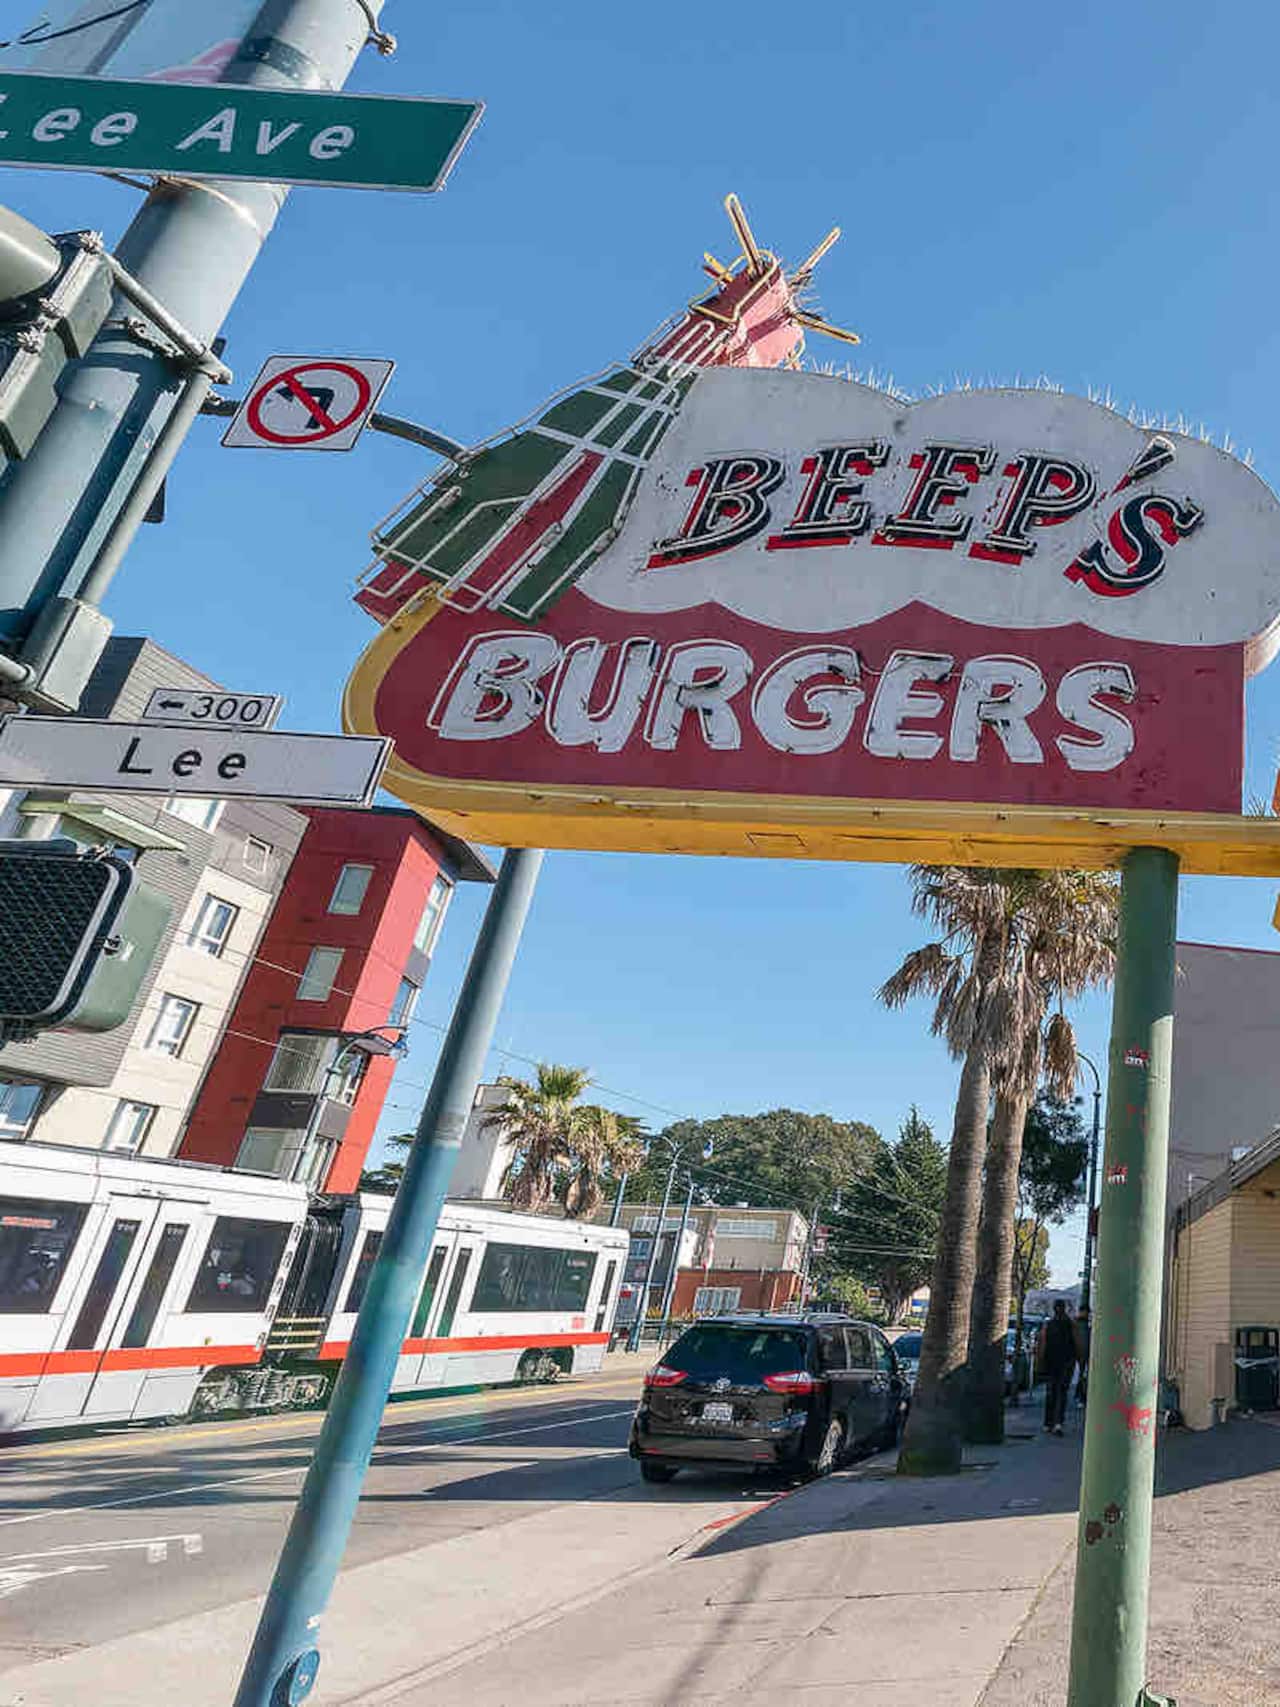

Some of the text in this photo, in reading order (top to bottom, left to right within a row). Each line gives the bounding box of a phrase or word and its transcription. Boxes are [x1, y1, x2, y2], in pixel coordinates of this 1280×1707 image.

[174, 107, 356, 159] Ave
[640, 435, 1204, 598] BEEP'S
[190, 696, 263, 722] 300
[427, 629, 1138, 771] BURGERS
[117, 736, 248, 780] Lee
